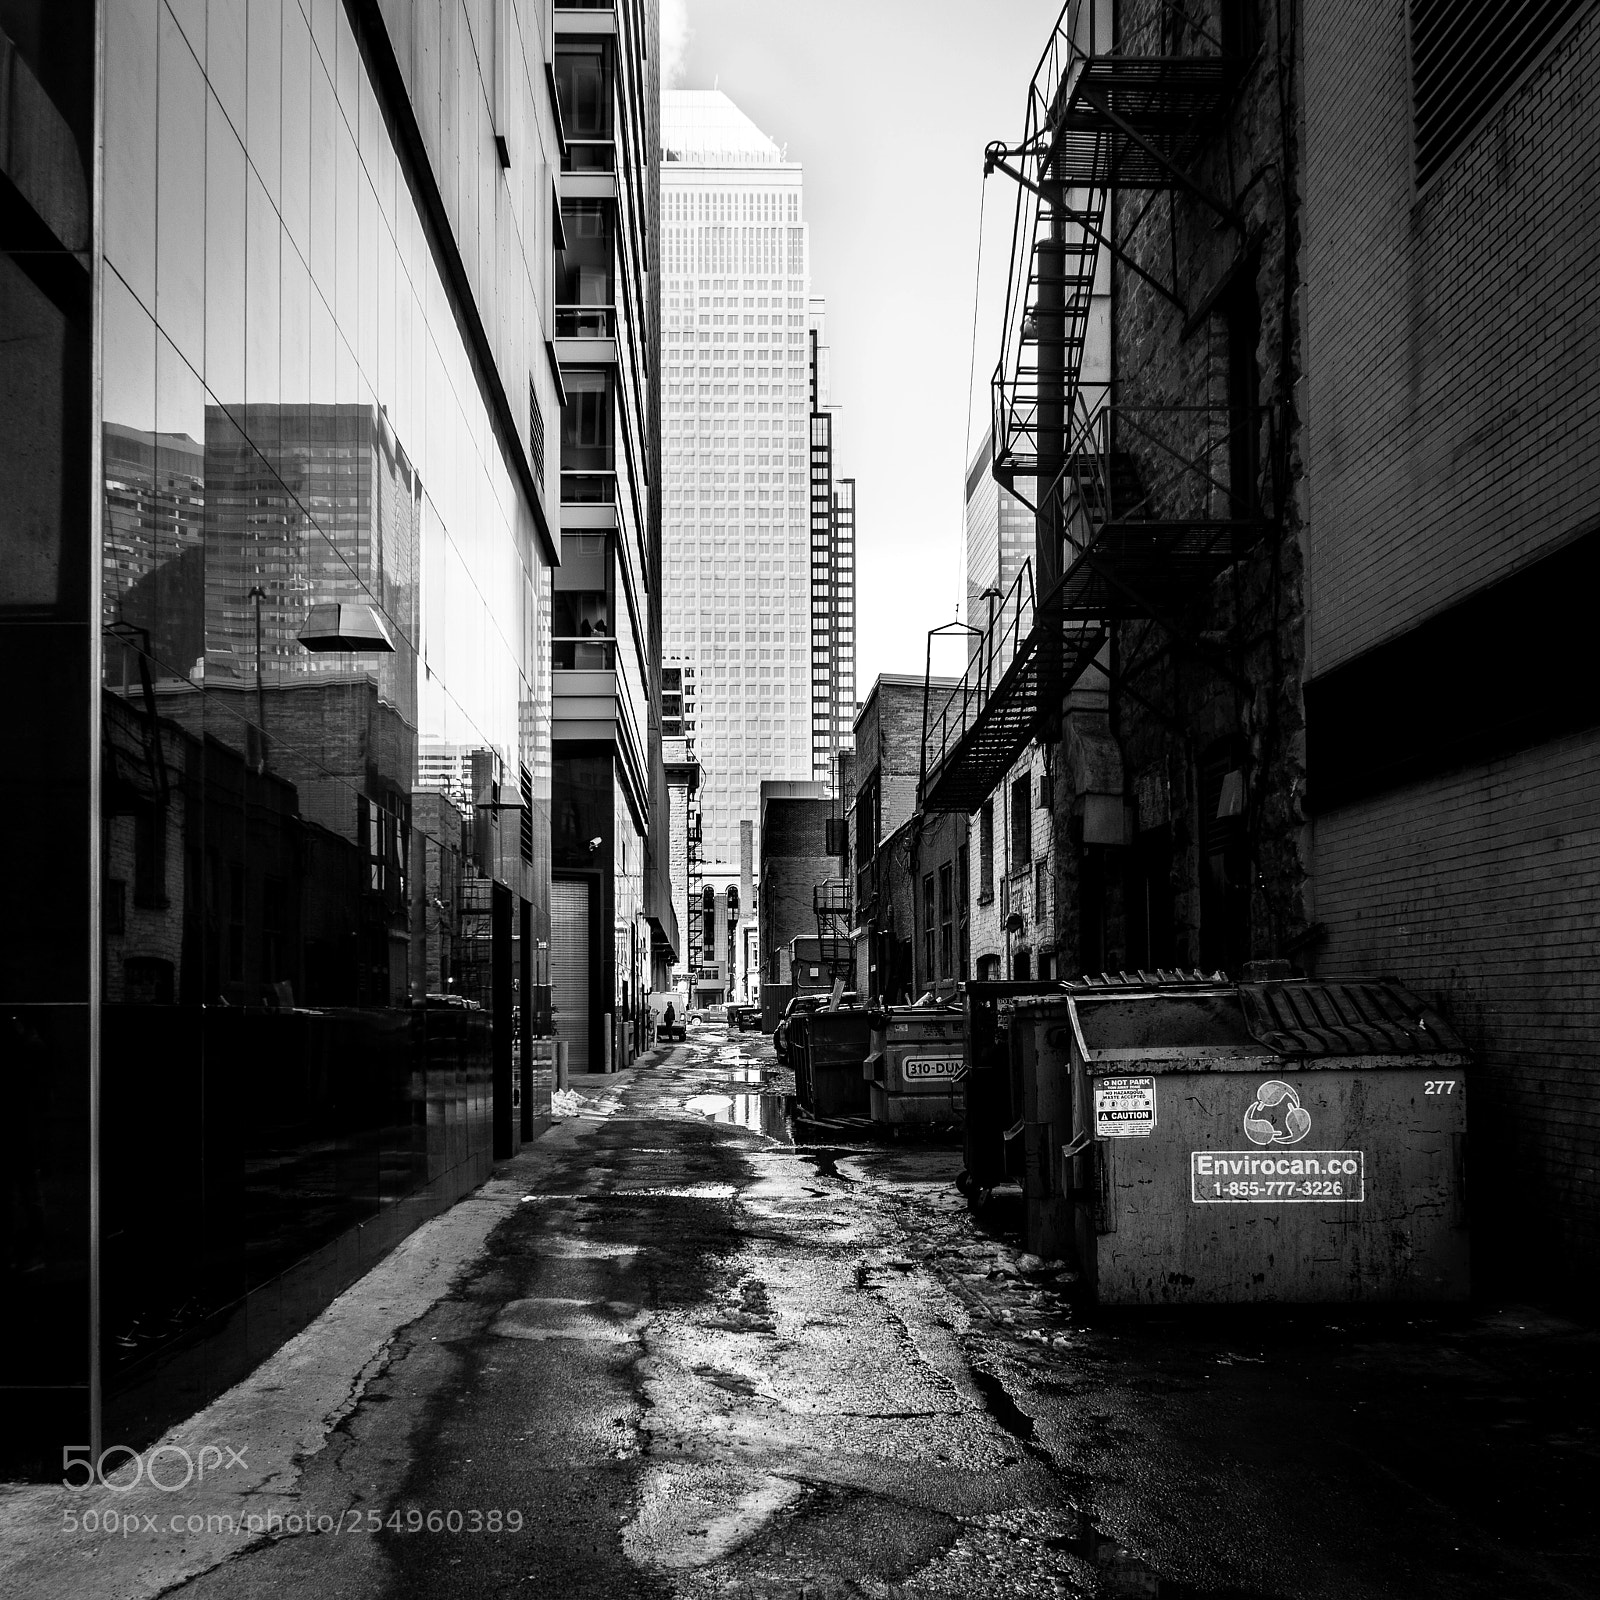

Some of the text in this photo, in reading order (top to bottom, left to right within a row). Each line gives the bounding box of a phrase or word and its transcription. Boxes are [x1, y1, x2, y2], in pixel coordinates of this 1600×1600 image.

[1129, 1078, 1150, 1086] PARK
[1424, 1080, 1456, 1095] 277
[1111, 1111, 1149, 1120] CAUTION
[1197, 1155, 1358, 1175] Envirocan.co
[1213, 1181, 1343, 1196] 1-855-777-3226
